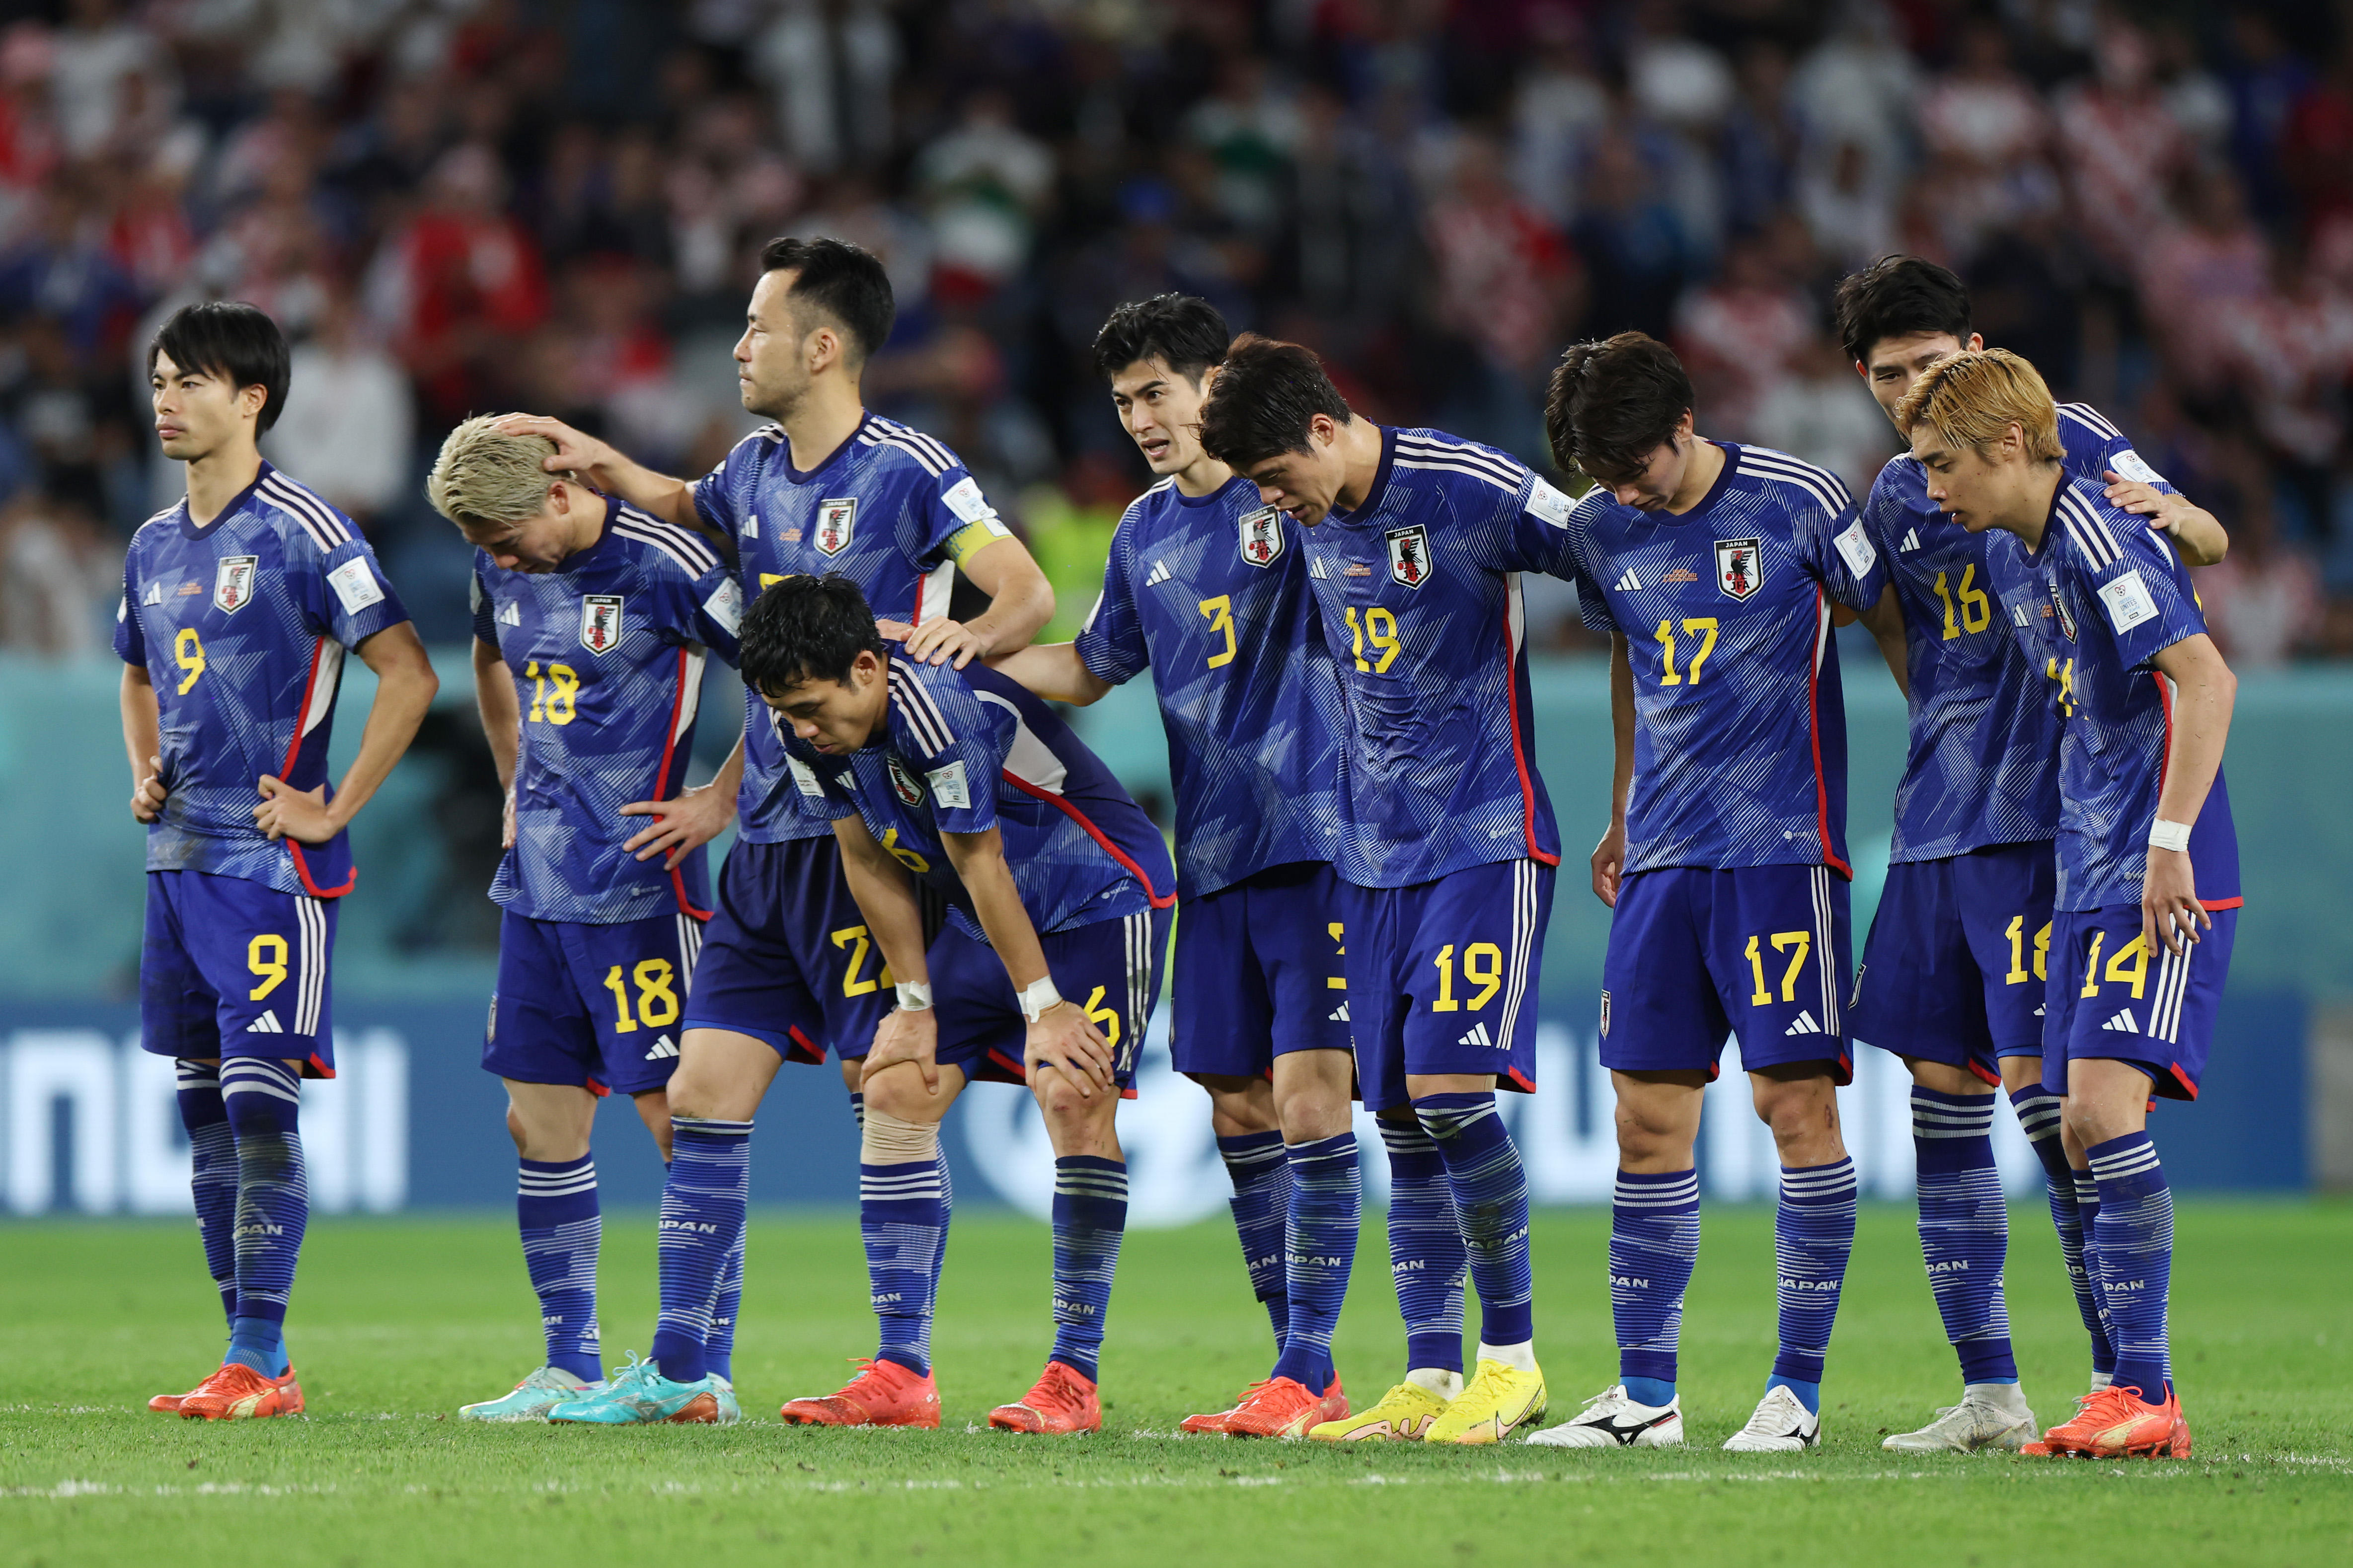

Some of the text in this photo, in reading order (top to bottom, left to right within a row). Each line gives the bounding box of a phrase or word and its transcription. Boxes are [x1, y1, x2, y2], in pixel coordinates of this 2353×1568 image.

[1248, 509, 1268, 521] JAPAN
[1394, 529, 1414, 538] JAPAN
[1199, 595, 1237, 669] 3
[1933, 563, 1990, 641] 16
[2120, 599, 2137, 611] UNITES
[175, 628, 206, 695] 9
[1345, 607, 1402, 674] 19
[1654, 617, 1719, 685] 17
[526, 661, 580, 725] 18
[881, 828, 930, 873] 6
[248, 934, 288, 1001] 9
[604, 958, 680, 1034] 18
[1433, 943, 1502, 1013] 19
[1744, 930, 1811, 1007] 17
[2081, 927, 2152, 999] 14
[1083, 985, 1121, 1048] 6
[233, 1224, 282, 1238] PAN
[2102, 1279, 2144, 1292] PAN
